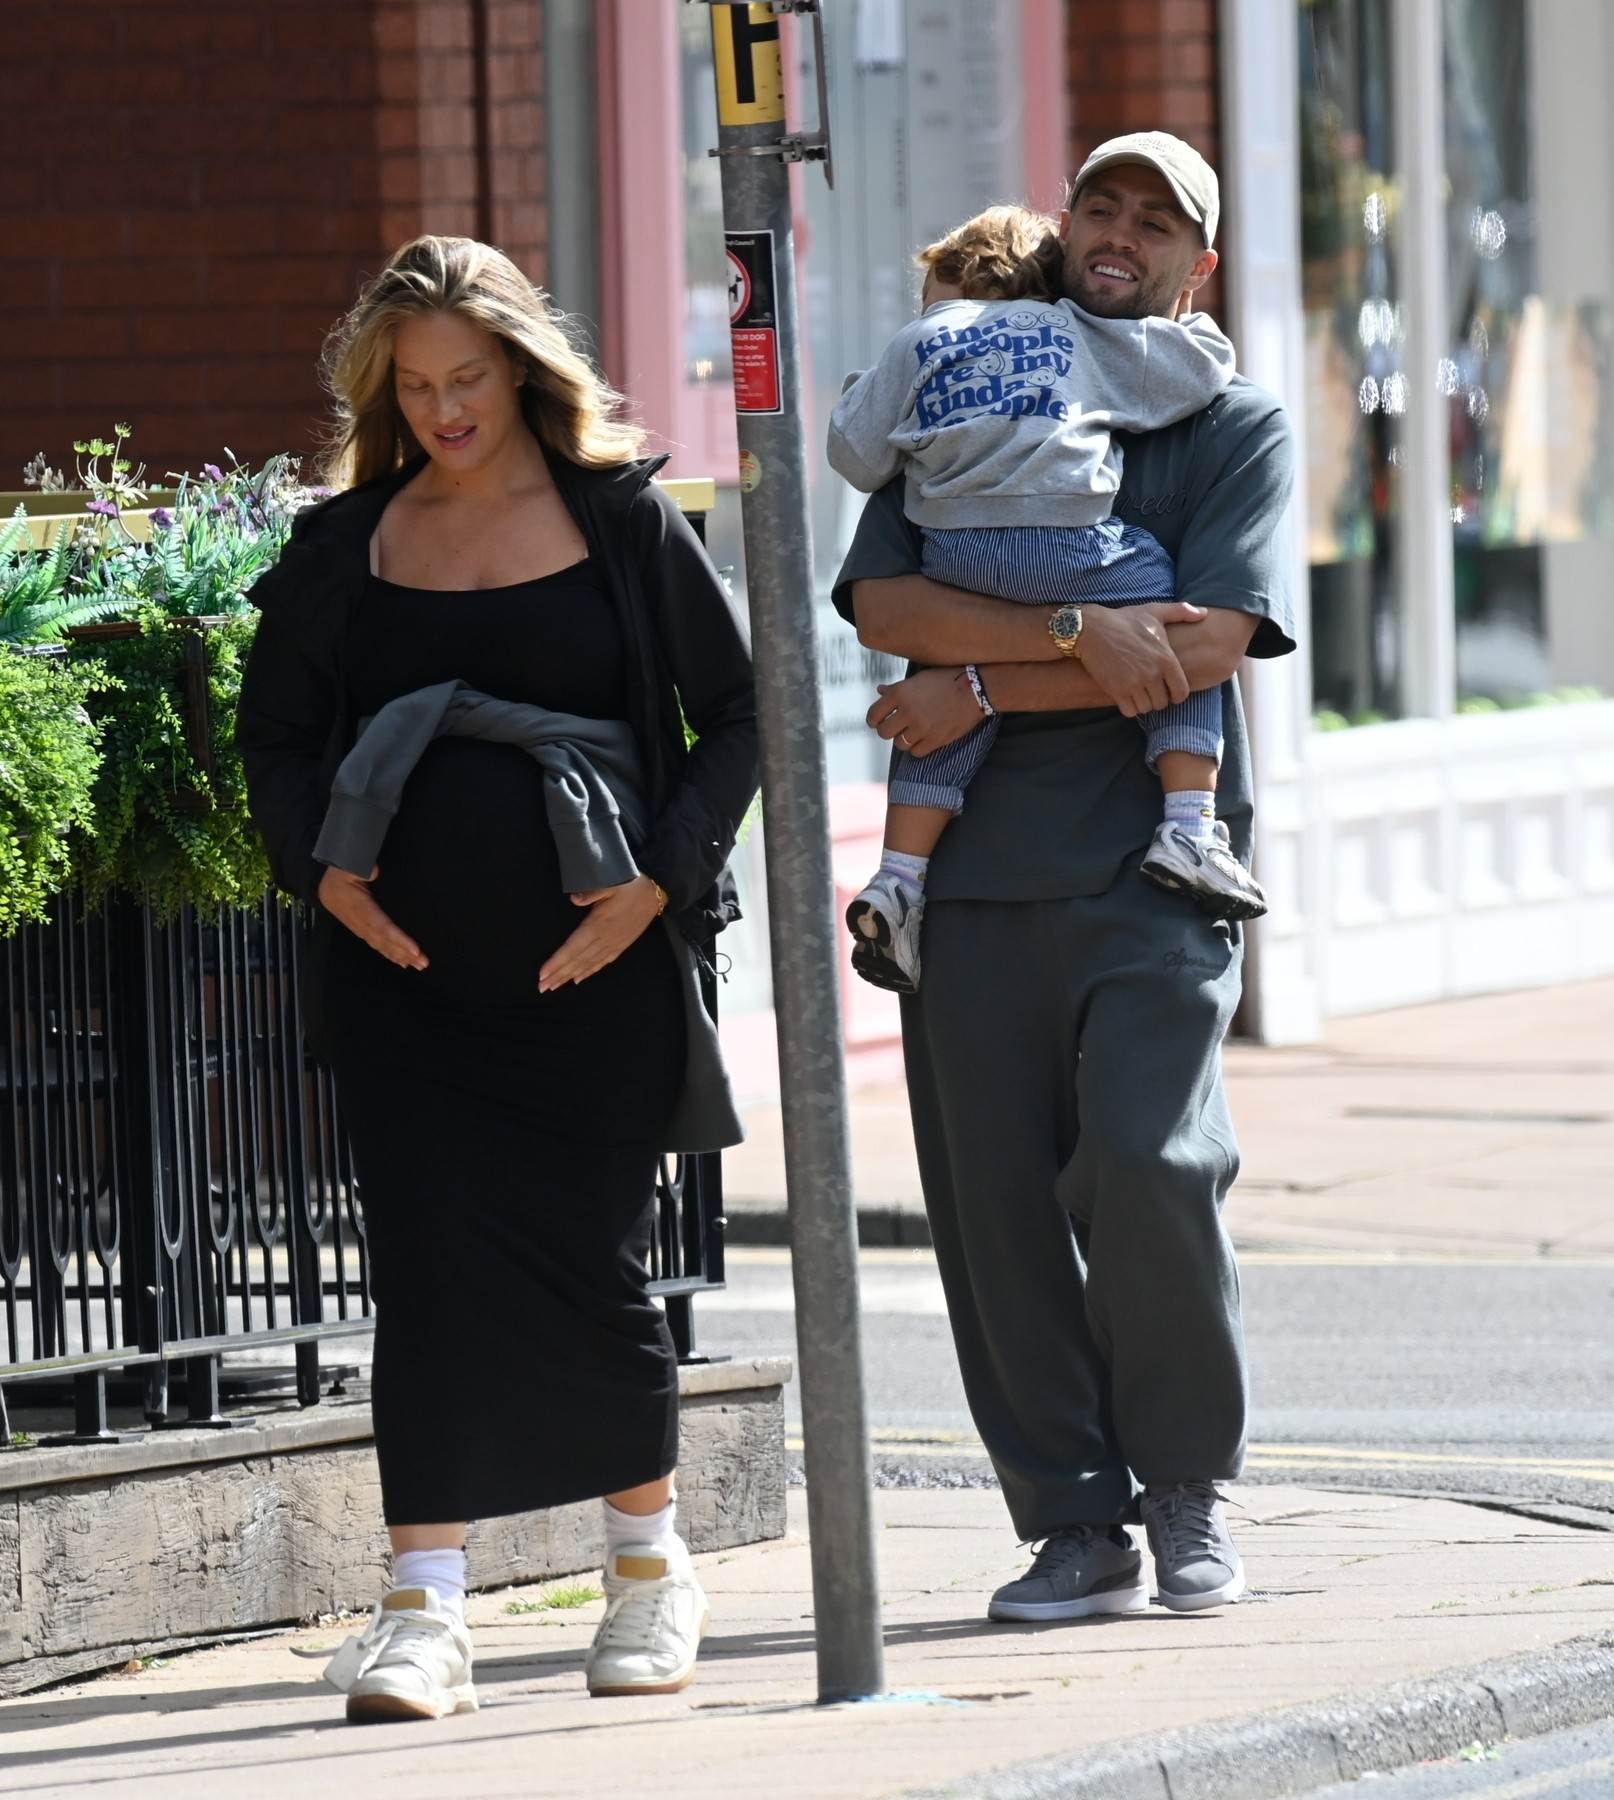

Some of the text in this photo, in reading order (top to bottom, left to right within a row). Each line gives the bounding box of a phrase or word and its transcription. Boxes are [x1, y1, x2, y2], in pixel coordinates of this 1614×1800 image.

[750, 333, 766, 341] DOG
[1011, 351, 1073, 378] my
[916, 375, 1026, 430] kinda
